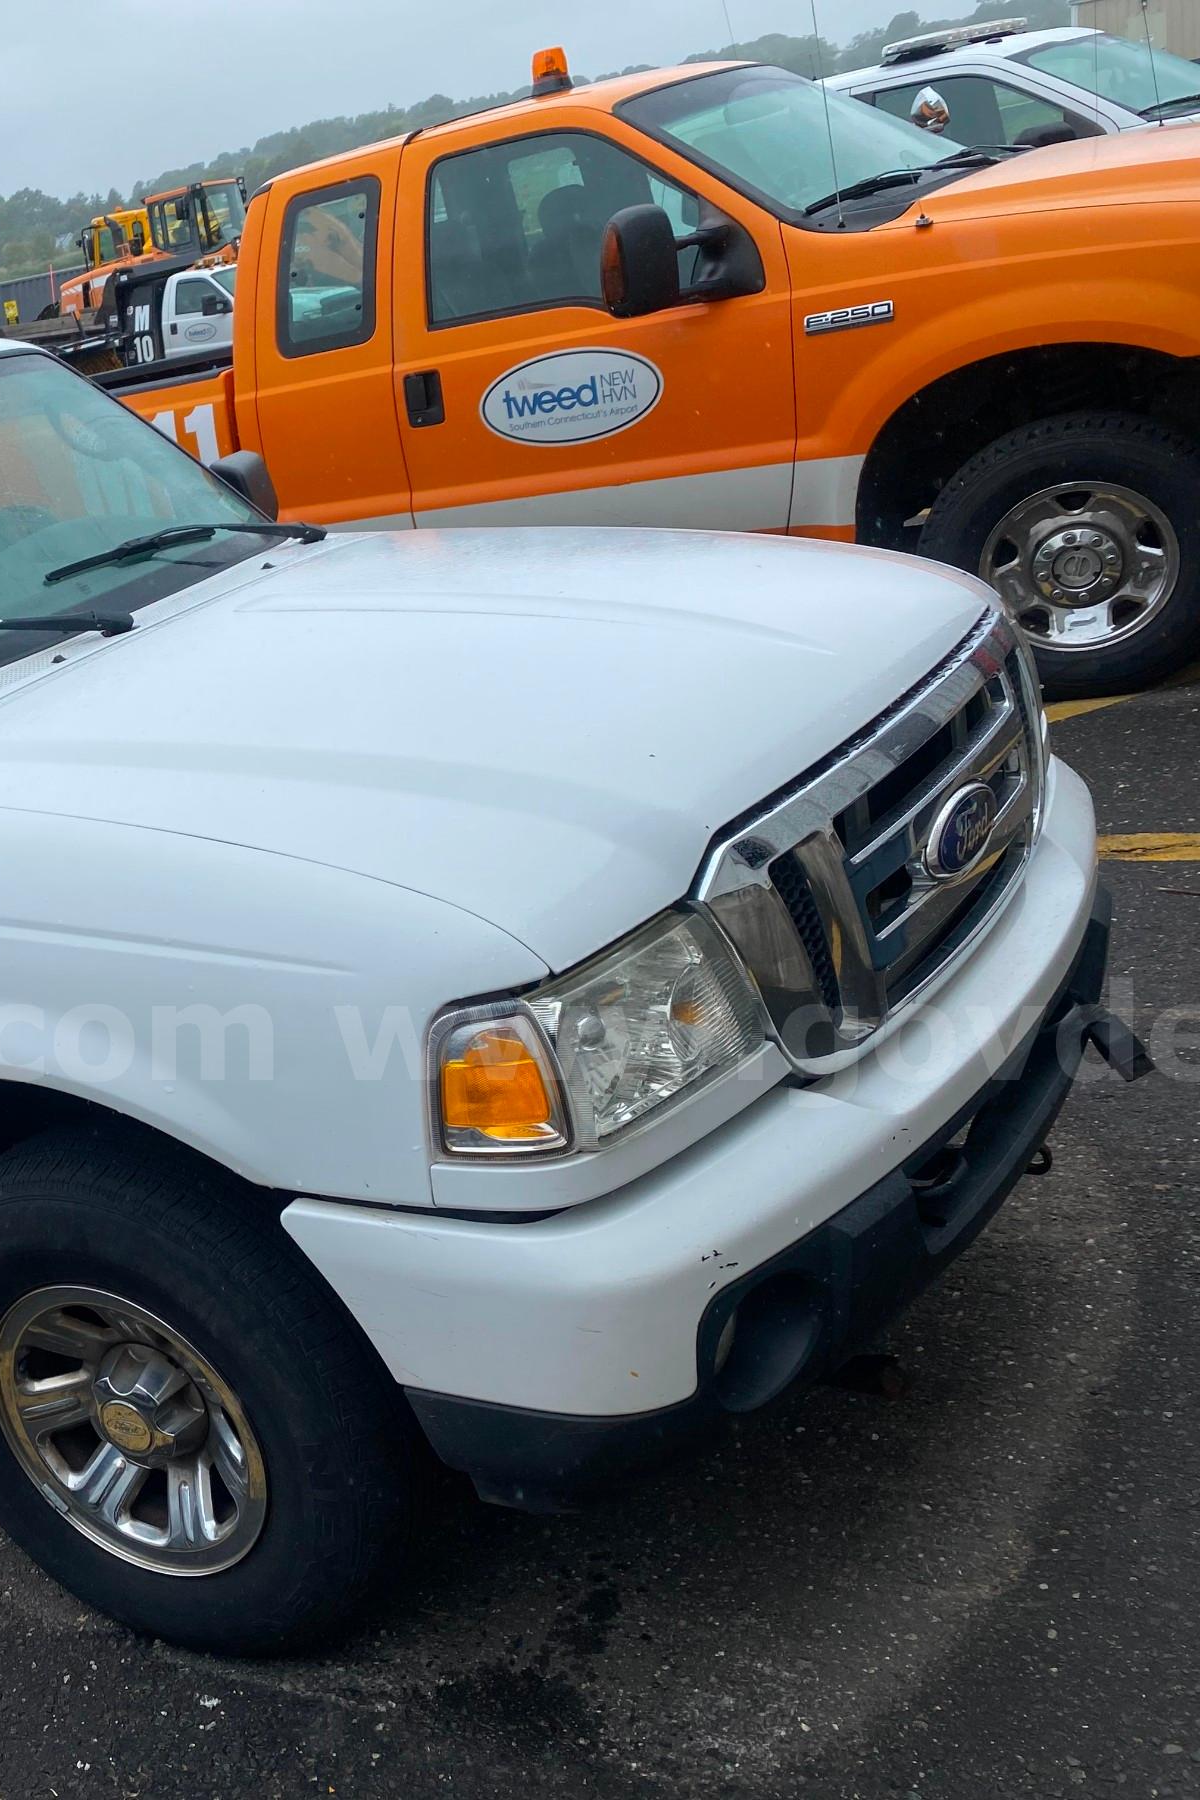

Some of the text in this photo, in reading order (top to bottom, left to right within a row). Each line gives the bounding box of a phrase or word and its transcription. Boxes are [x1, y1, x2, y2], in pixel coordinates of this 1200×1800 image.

[134, 304, 150, 332] M
[134, 335, 155, 363] 10
[600, 368, 635, 388] NEW
[502, 375, 599, 419] tweed
[602, 384, 637, 405] HVN
[509, 404, 639, 433] Southern Connecticut's Airport
[956, 800, 994, 861] Ford
